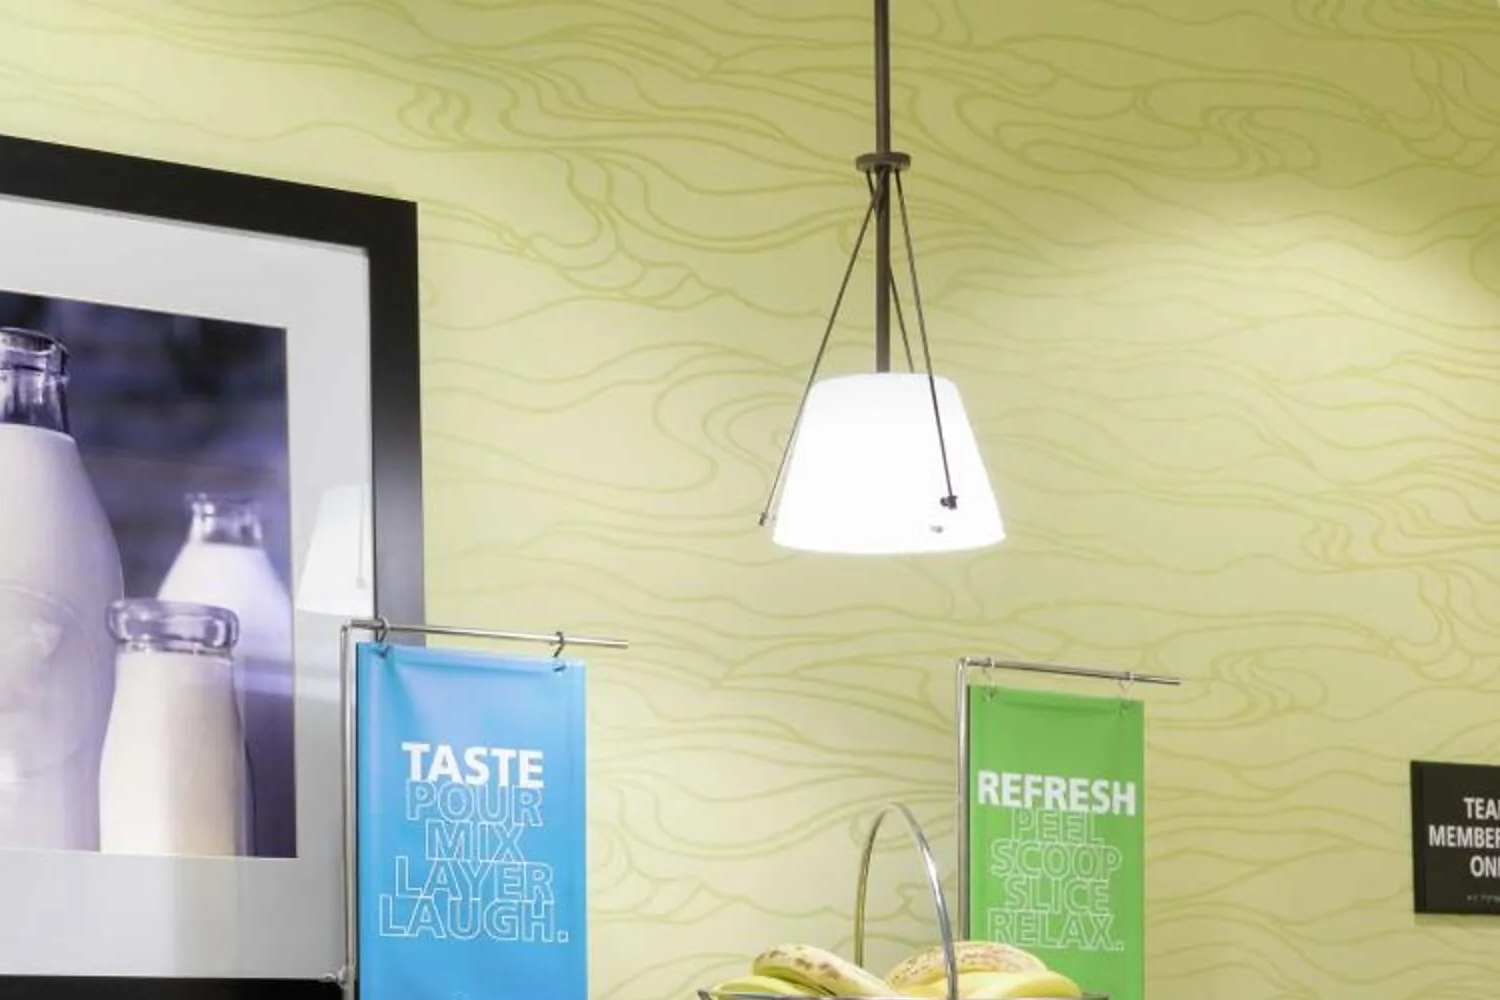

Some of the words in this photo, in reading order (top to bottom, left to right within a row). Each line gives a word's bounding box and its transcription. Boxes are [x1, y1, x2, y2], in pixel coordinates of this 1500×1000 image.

[402, 742, 545, 788] TASTE
[405, 778, 544, 827] POUR
[978, 770, 1136, 816] REFRESH
[425, 819, 526, 863] MIX
[1011, 807, 1105, 846] PEEL
[395, 855, 555, 906] LAYER
[990, 837, 1124, 880] SCOOP
[1004, 872, 1110, 916] SLICE
[378, 893, 570, 944] LAUGH.
[987, 907, 1125, 952] RELAX.
